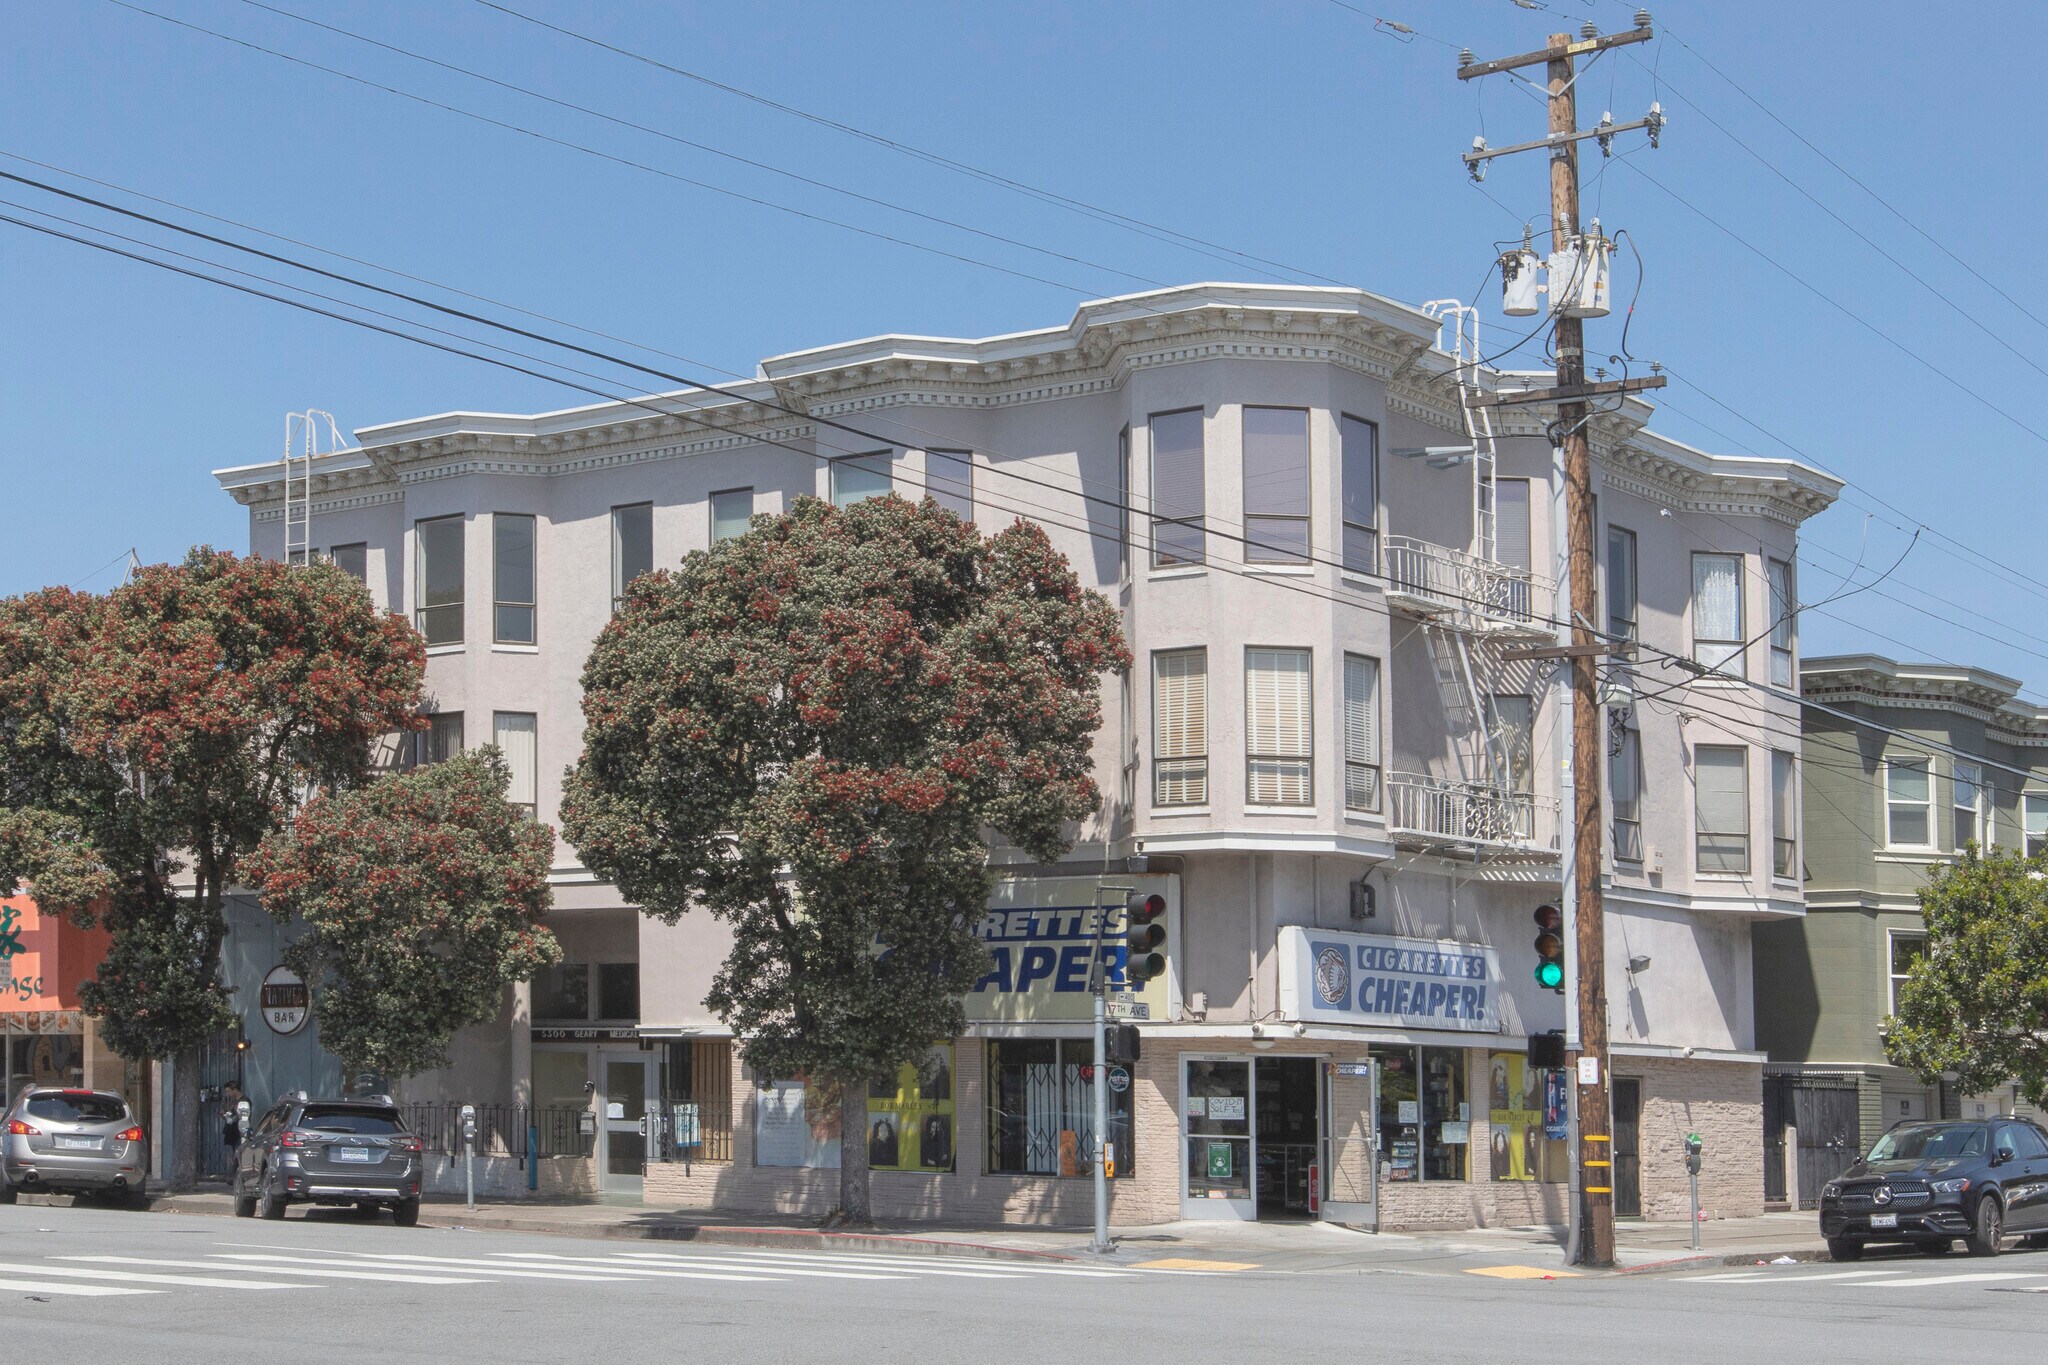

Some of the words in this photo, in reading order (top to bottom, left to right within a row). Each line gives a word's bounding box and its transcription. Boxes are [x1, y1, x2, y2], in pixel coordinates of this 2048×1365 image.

[1362, 949, 1481, 977] CIGARETTES
[1358, 977, 1487, 1021] CHEAPER!
[1107, 1004, 1126, 1015] 17TH
[1130, 1006, 1147, 1016] AVE
[274, 1012, 295, 1022] BAR
[574, 1030, 598, 1038] GEARY
[609, 1029, 639, 1039] MEDICAL
